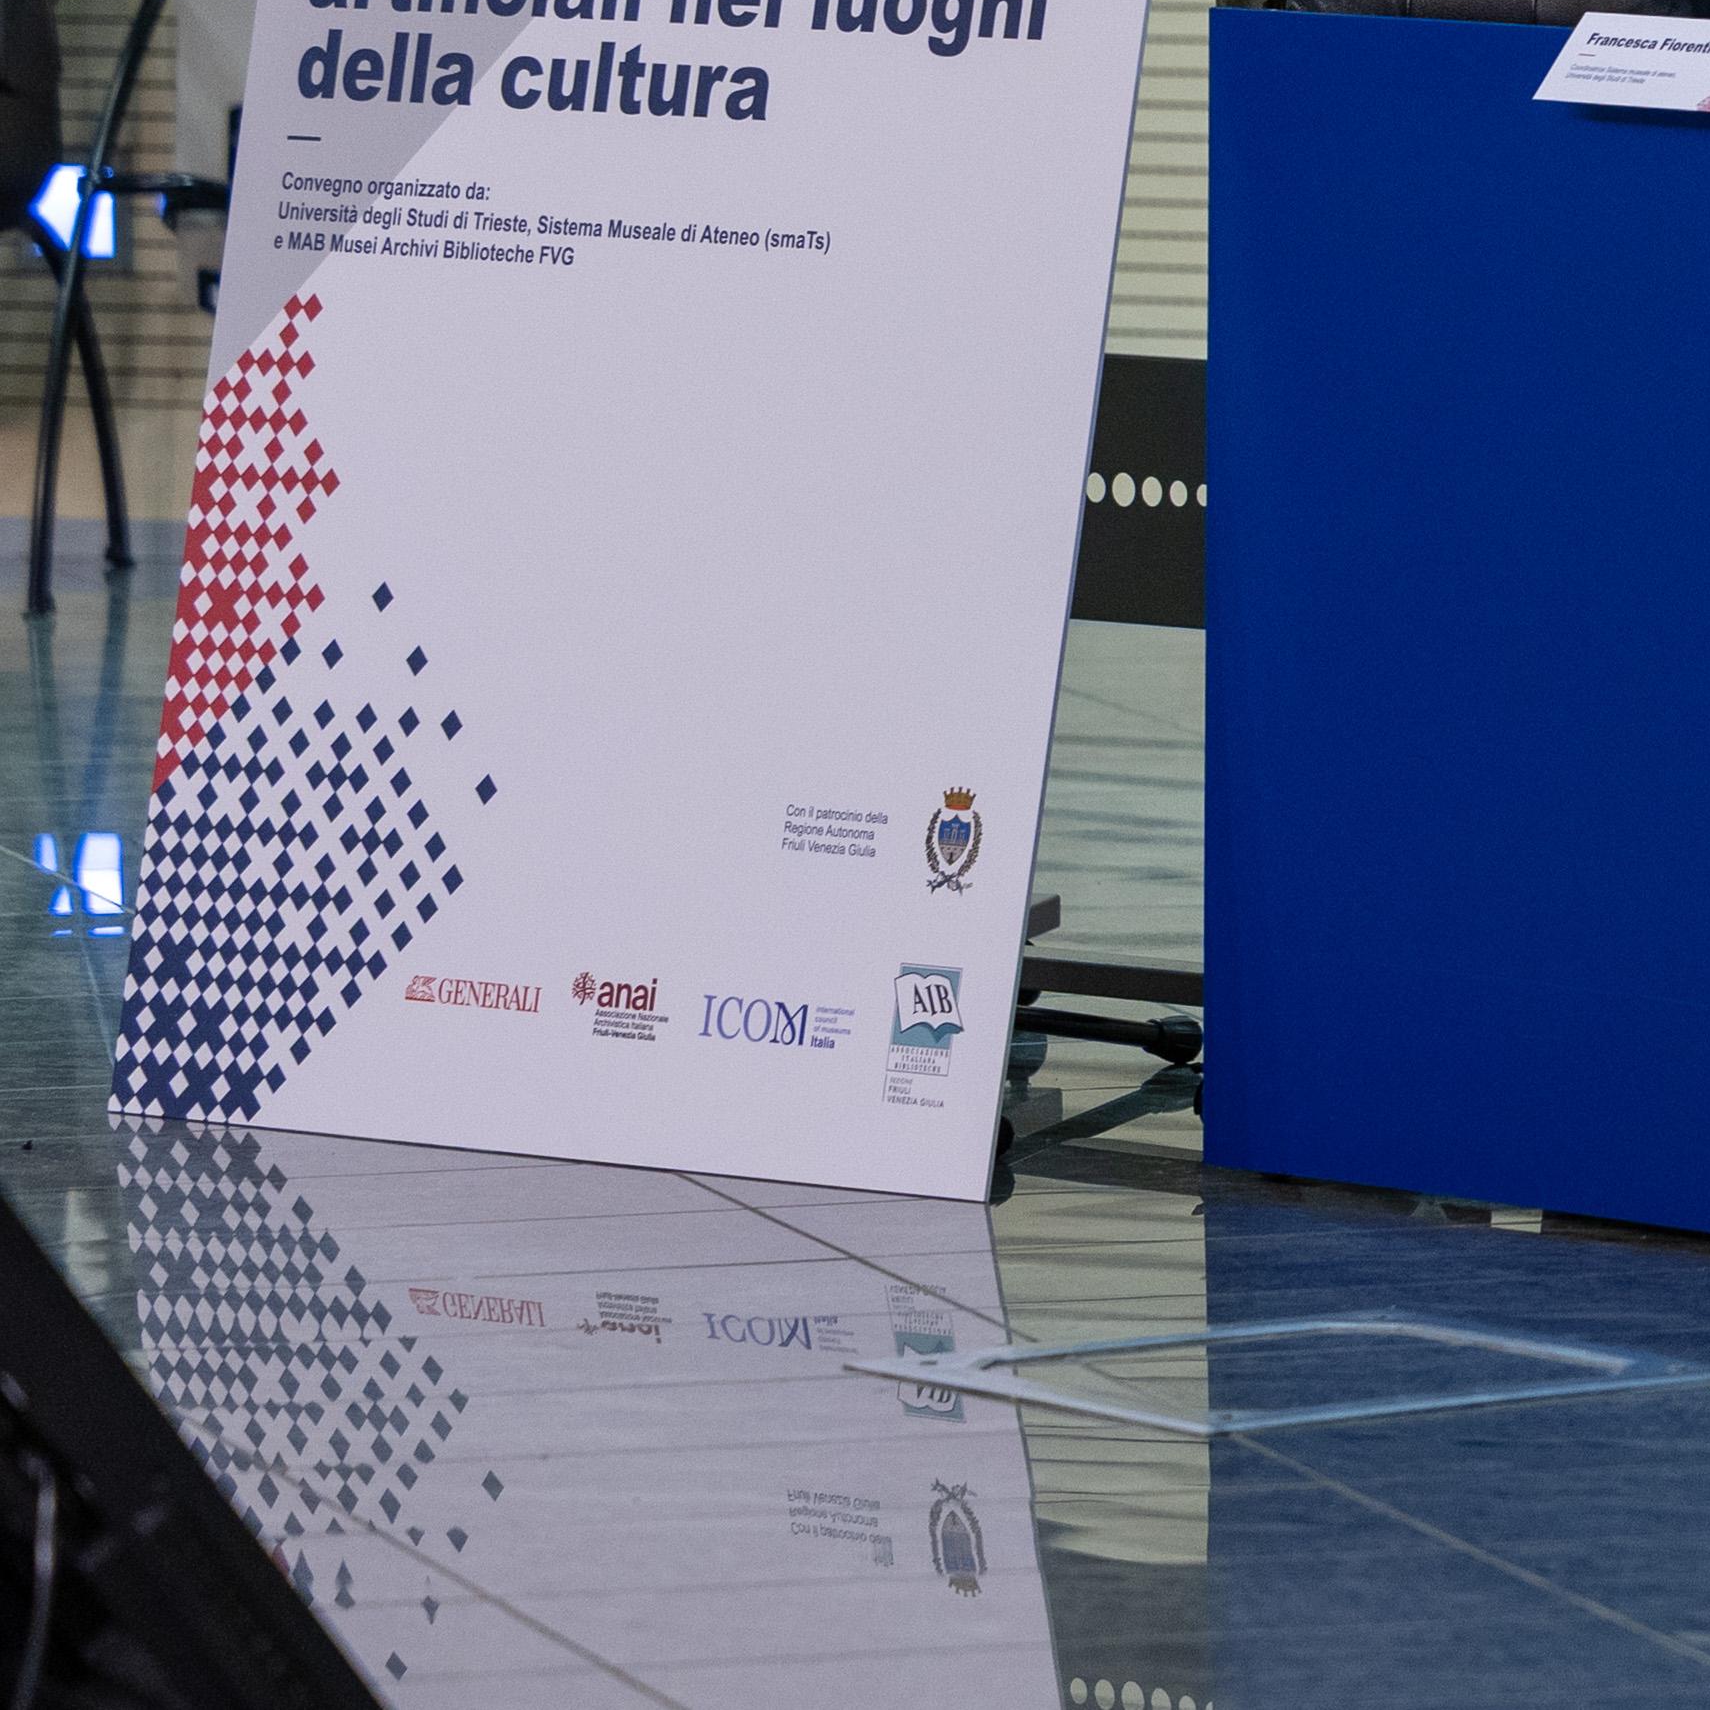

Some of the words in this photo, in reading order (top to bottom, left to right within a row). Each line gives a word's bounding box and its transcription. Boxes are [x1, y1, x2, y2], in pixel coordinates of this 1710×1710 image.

[1586, 32, 1657, 51] Francesca
[297, 28, 475, 106] della
[500, 41, 769, 121] cultura
[281, 171, 363, 198] Convegno
[366, 178, 461, 200] organizzato
[465, 181, 491, 201] da:
[278, 200, 358, 224] Università
[362, 205, 402, 230] degli
[406, 207, 449, 228] Studi
[452, 210, 469, 230] di
[473, 211, 531, 237] Trieste,
[536, 214, 603, 237] Sistema
[607, 218, 676, 242] Museale
[680, 223, 697, 242] di
[699, 224, 760, 246] Ateneo
[764, 227, 831, 255] (smaTs)
[273, 235, 284, 249] e
[287, 231, 326, 251] MAB
[329, 233, 378, 254] Musei
[379, 236, 439, 258] Archivi
[442, 239, 535, 264] Biblioteche
[538, 245, 575, 266] FVG
[783, 820, 824, 838] Regione
[824, 824, 875, 841] Autonoma
[785, 803, 807, 817] Con
[807, 805, 815, 818] il
[814, 808, 863, 823] patrocinio
[864, 810, 889, 825] della
[781, 836, 806, 852] Friuli
[807, 839, 846, 855] Venezia
[847, 843, 877, 858] Giulia
[437, 977, 542, 1013] GENERALI
[597, 978, 658, 1012] anai
[913, 983, 953, 1016] AIB
[698, 994, 809, 1046] ICOM
[809, 1034, 835, 1049] Italia
